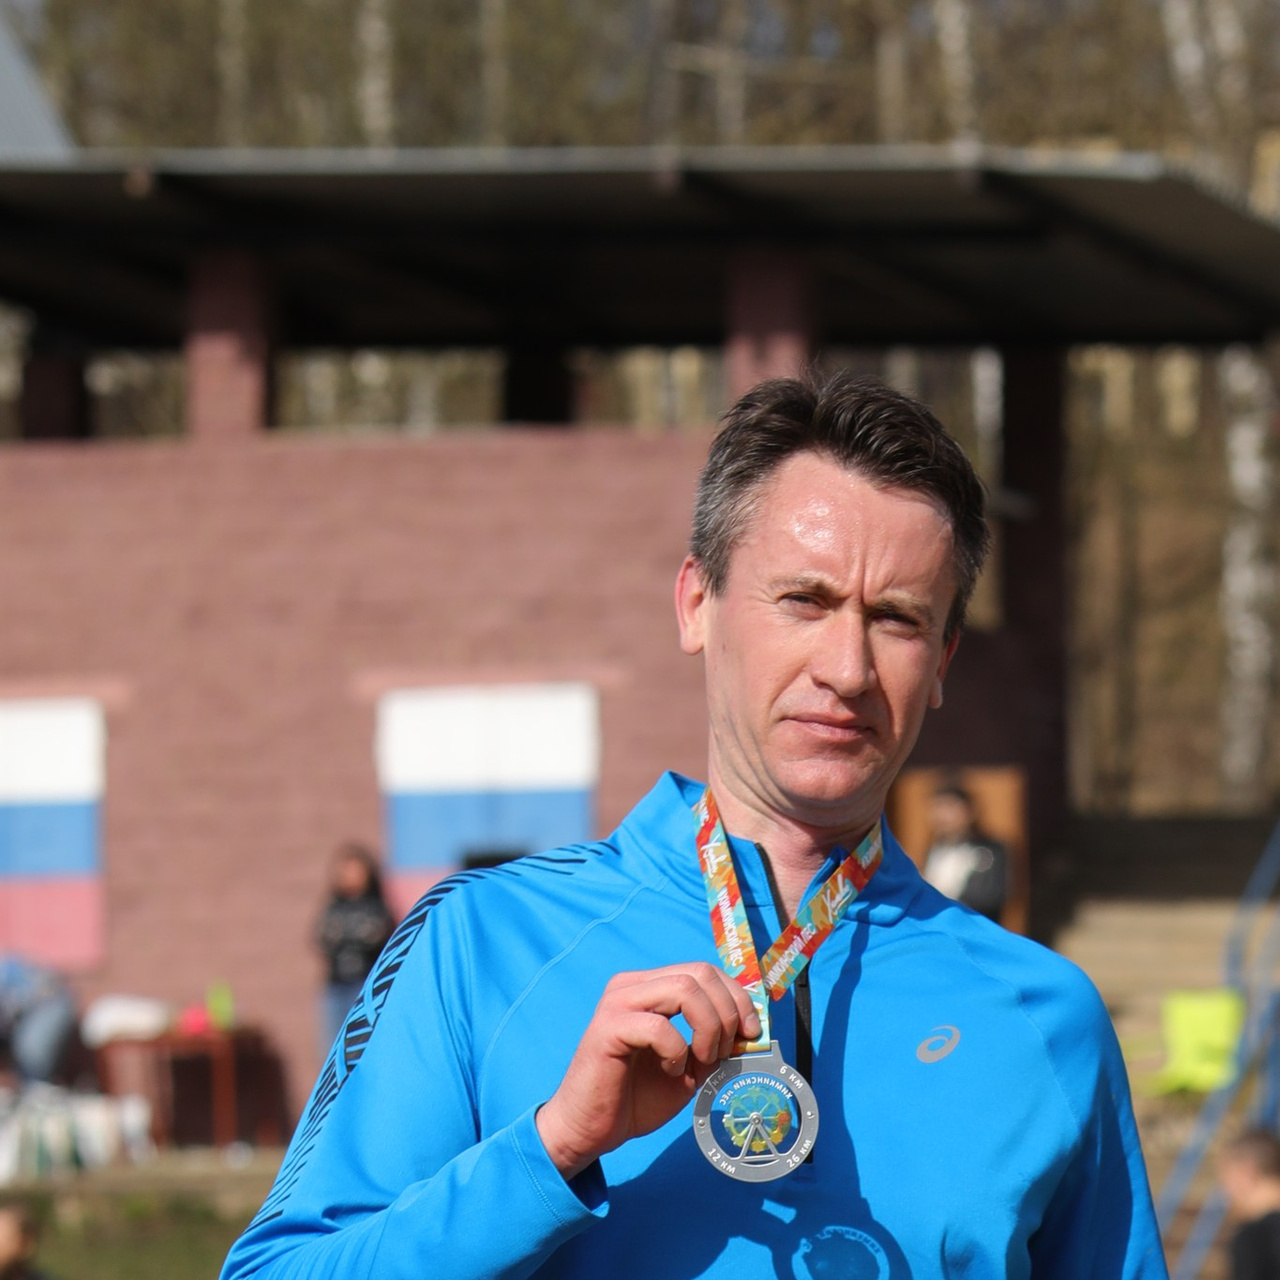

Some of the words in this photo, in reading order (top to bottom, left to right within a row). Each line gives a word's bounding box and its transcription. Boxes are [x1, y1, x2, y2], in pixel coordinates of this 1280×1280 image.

[780, 1066, 788, 1075] 6
[707, 1148, 719, 1162] 12
[786, 1156, 800, 1168] 26
